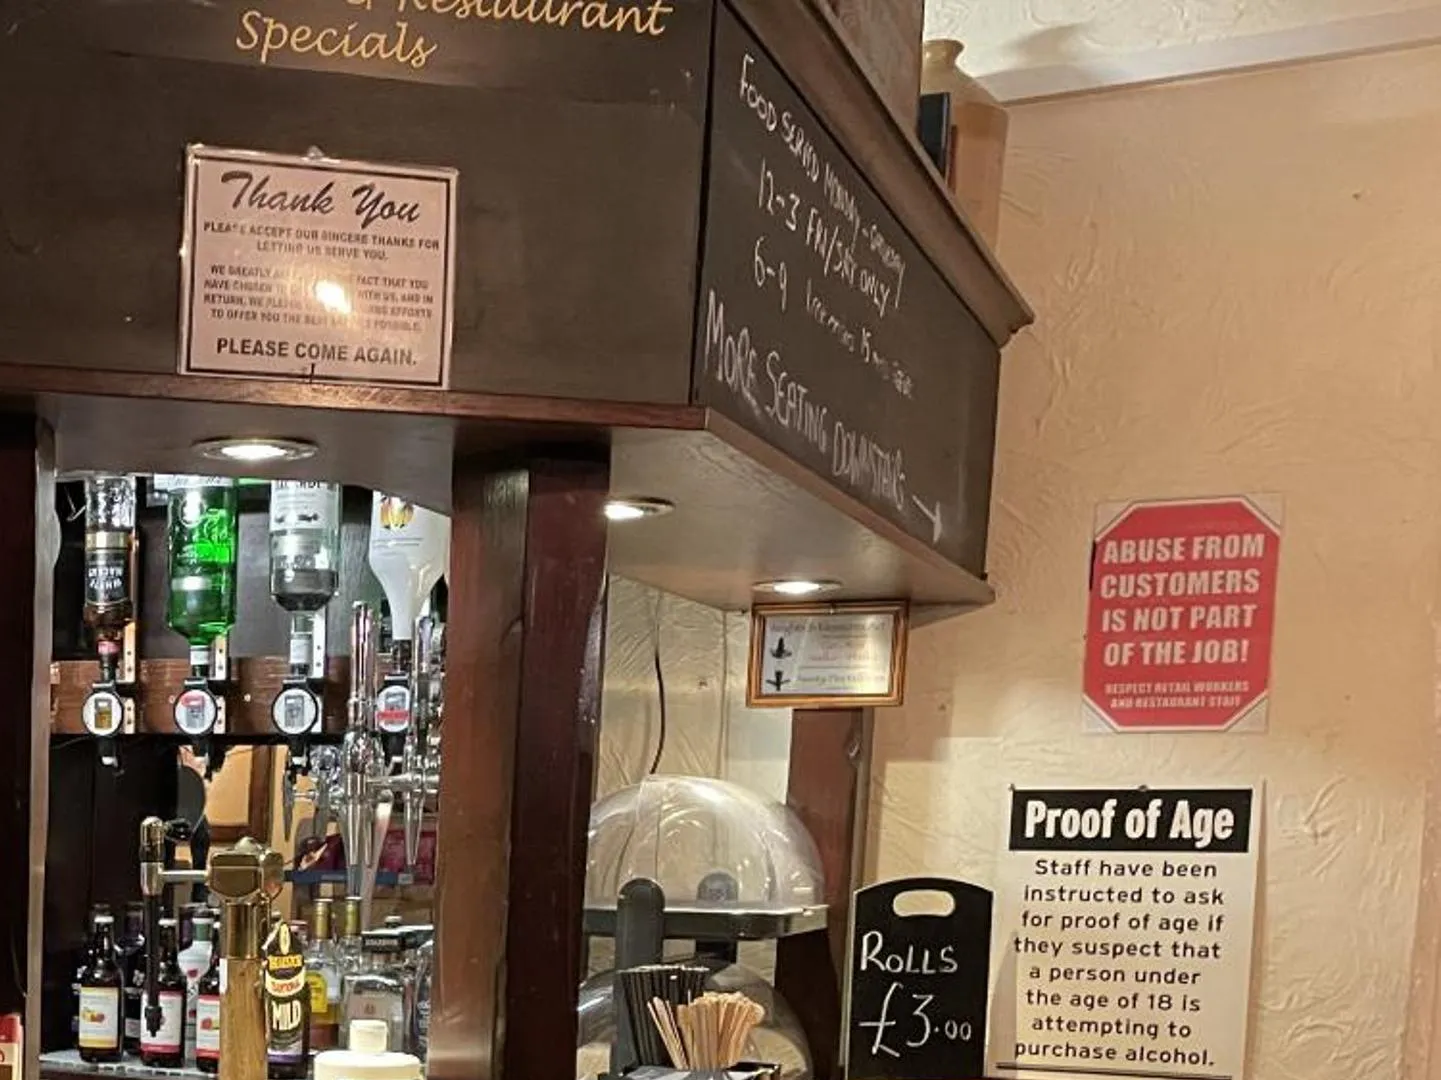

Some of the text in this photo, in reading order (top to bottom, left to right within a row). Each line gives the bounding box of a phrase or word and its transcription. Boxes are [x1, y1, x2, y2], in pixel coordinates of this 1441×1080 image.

[236, 10, 439, 68] Specials
[740, 53, 777, 131] FOOD
[221, 170, 420, 229] Thank You
[759, 157, 800, 232] 12-3
[250, 225, 292, 239] ACCEPT
[296, 229, 318, 240] OUR
[321, 230, 368, 245] SINCERE
[372, 235, 415, 249] THANKS
[418, 238, 440, 250] FOR
[211, 264, 226, 275] WE
[228, 265, 271, 278] GREATLY
[203, 279, 229, 290] HAVE
[210, 309, 224, 319] TO
[227, 309, 257, 321] OFFER
[216, 337, 418, 366] PLEASE COME AGAIN.
[1103, 533, 1265, 564] ABUSE FROM
[1100, 568, 1261, 599] CUSTOMERS
[1102, 603, 1258, 633] IS NOT PART
[1103, 638, 1249, 666] OF THE JOB!
[1104, 682, 1152, 694] RESPECT
[1193, 680, 1250, 693] WORKERS
[1110, 697, 1132, 708] AND
[1135, 696, 1205, 708] RESTAURANT
[1025, 799, 1236, 850] Proof of Age
[1035, 859, 1218, 879] Staff have been
[1024, 885, 1224, 905] instructed to ask
[1021, 911, 1225, 936] for proof of age if
[1013, 936, 1221, 963] they suspect that
[1029, 966, 1202, 987] a person under
[1026, 988, 1201, 1014] the age of 18 is
[272, 999, 302, 1031] MILD
[1031, 1015, 1192, 1040] attempting to
[1014, 1041, 1215, 1067] purchase alcohol.
